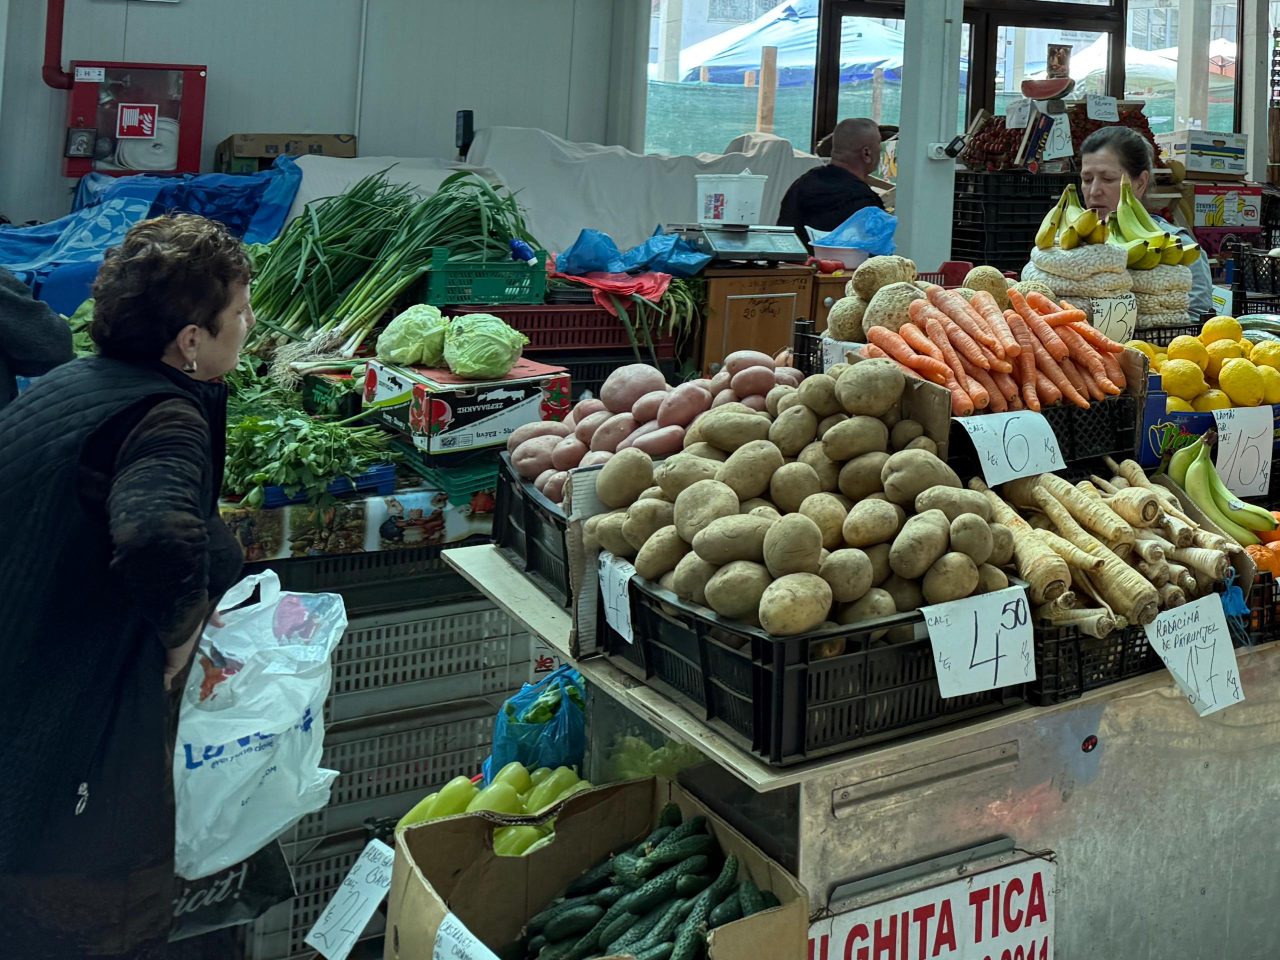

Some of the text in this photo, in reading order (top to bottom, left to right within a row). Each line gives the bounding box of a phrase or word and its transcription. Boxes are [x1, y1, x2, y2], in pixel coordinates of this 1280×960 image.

[1002, 416, 1030, 473] 6
[1222, 427, 1268, 491] 15
[968, 610, 1008, 686] 4
[1000, 597, 1028, 630] 50
[172, 862, 248, 917] icit!
[844, 871, 1048, 960] GHITA TICA
